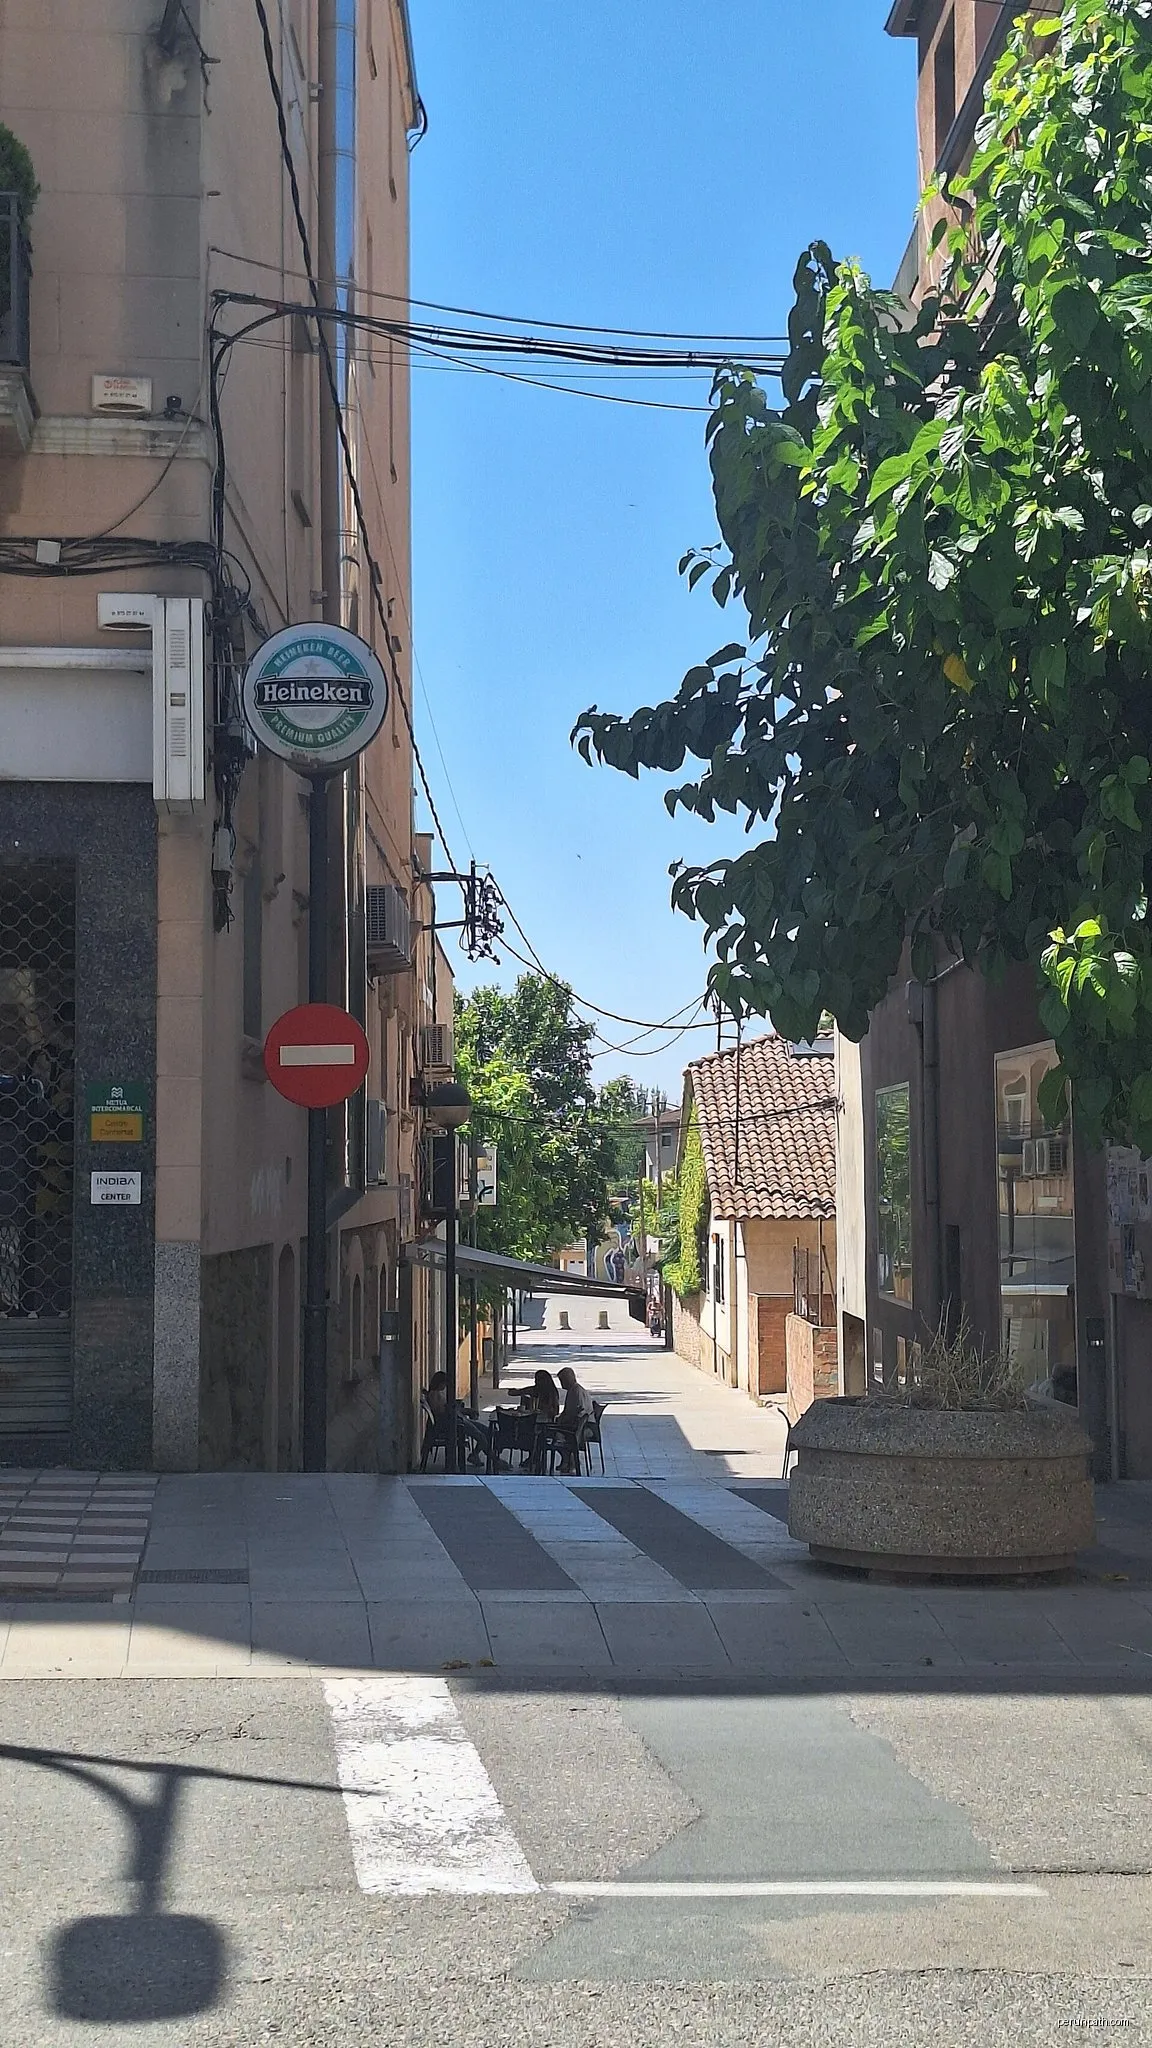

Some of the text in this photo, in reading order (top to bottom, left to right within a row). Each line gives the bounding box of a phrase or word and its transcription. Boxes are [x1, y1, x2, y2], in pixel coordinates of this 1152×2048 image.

[273, 642, 351, 668] HEINEKEN BEER
[263, 682, 363, 702] Heineken
[270, 715, 356, 743] PREMIUM QUALITY
[96, 1177, 136, 1185] INDIBA
[100, 1193, 131, 1201] CENTER
